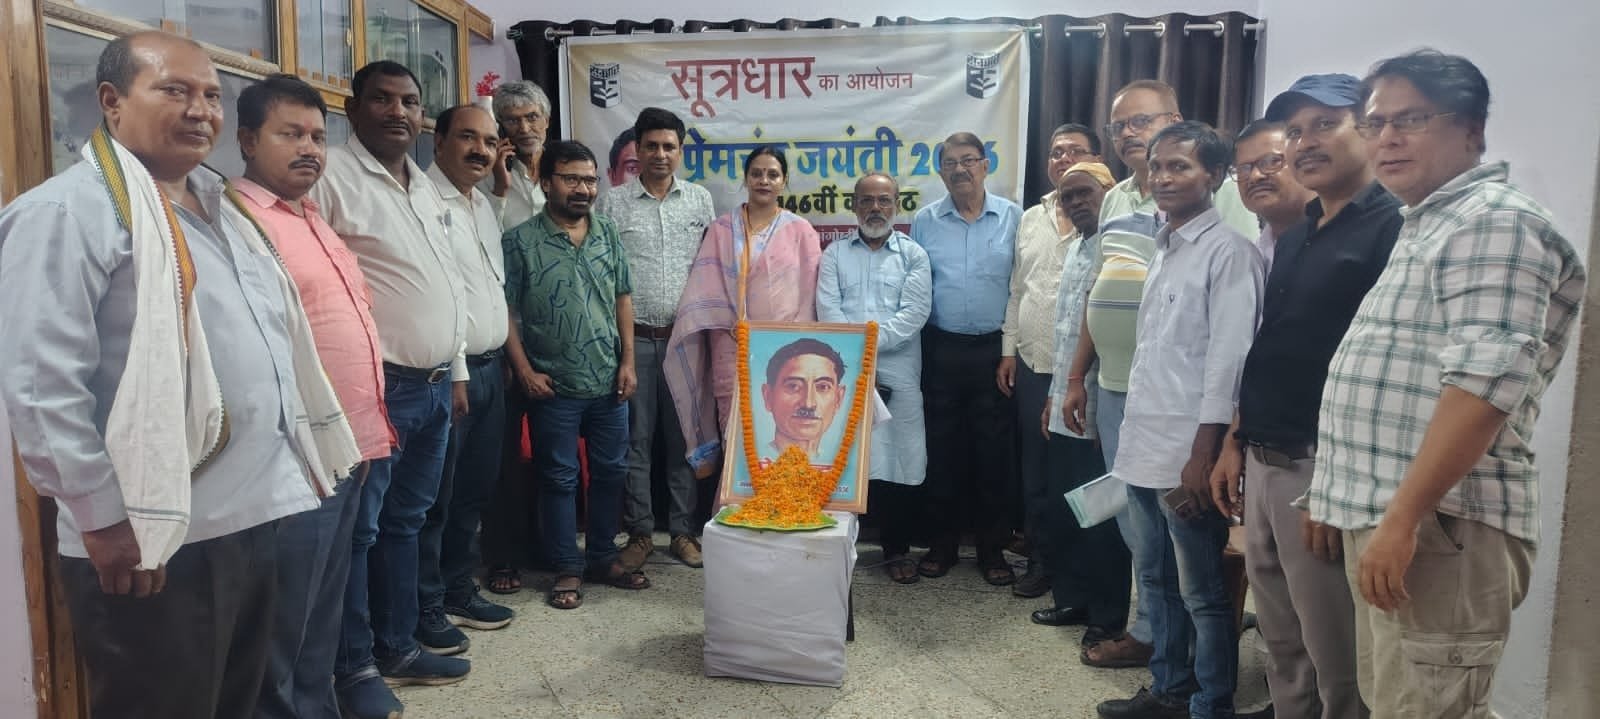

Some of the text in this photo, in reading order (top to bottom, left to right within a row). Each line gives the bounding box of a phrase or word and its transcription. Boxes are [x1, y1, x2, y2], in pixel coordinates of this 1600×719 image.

[665, 57, 913, 118] सूत्रधार का आयोजन
[794, 125, 903, 178] जयंती
[910, 141, 999, 177] 26
